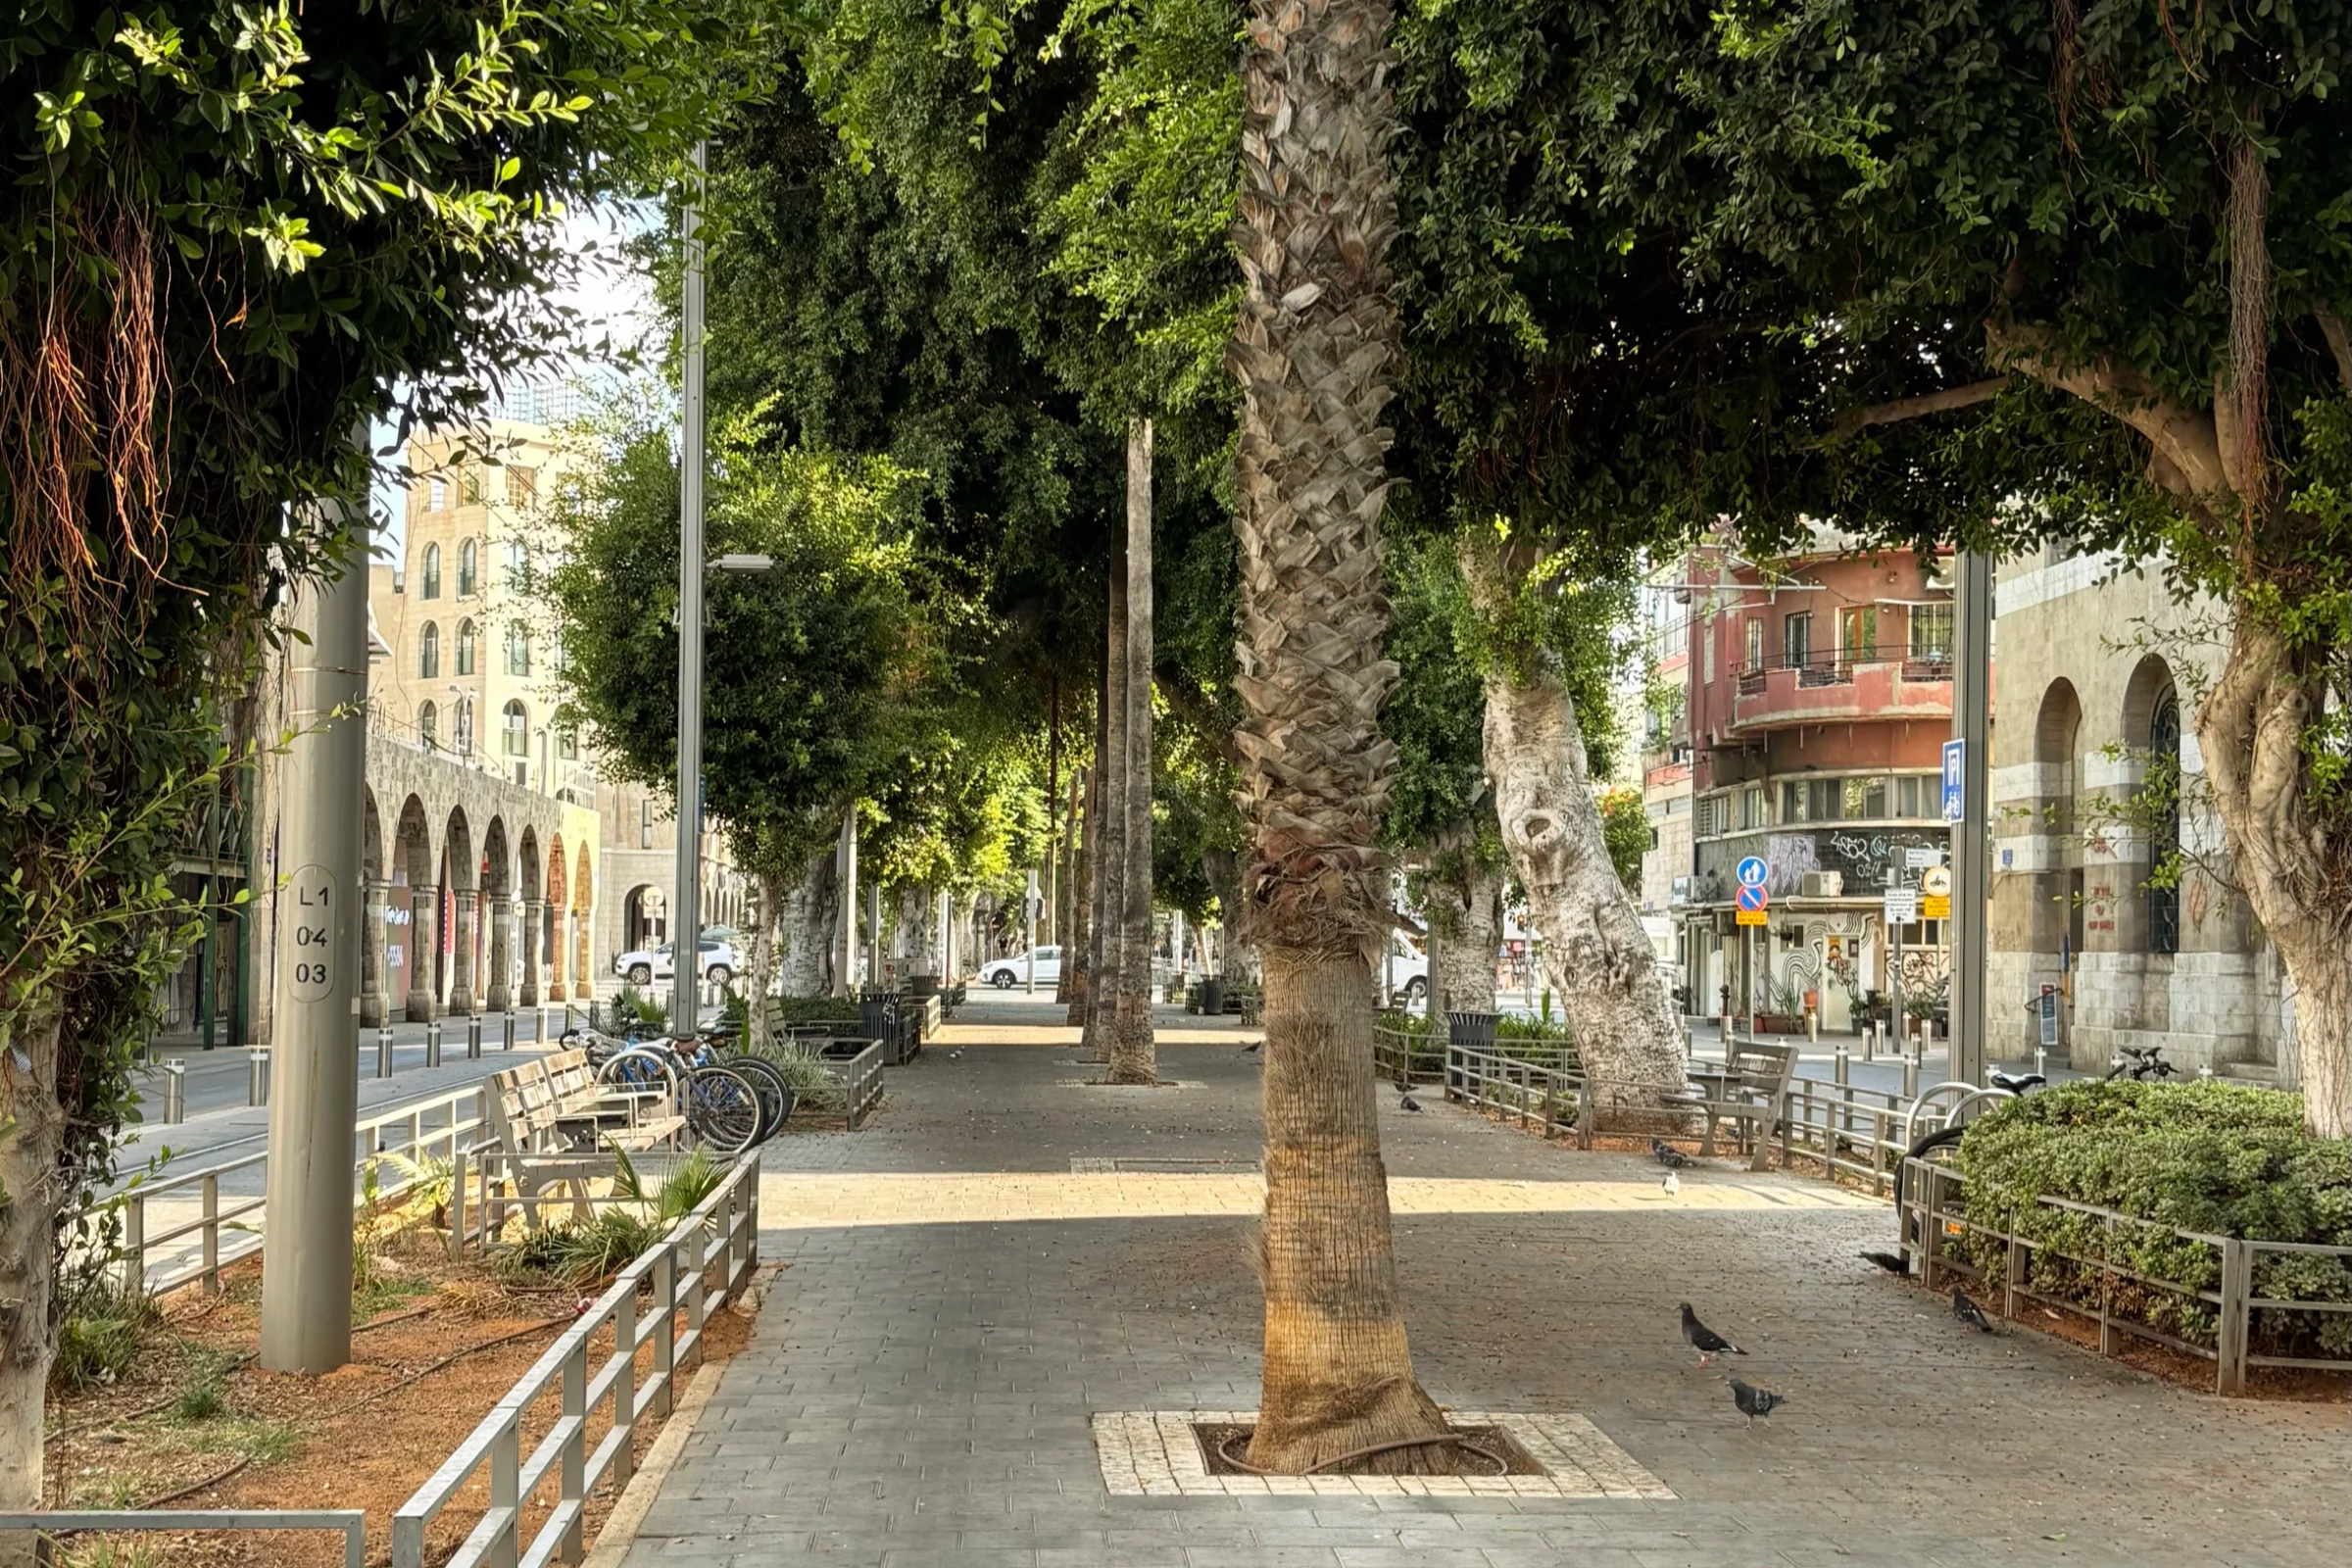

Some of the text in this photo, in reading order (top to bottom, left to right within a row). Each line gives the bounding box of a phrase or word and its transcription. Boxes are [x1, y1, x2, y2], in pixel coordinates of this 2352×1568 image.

[299, 886, 328, 906] L1
[296, 926, 328, 948] 04
[295, 963, 327, 984] 03
